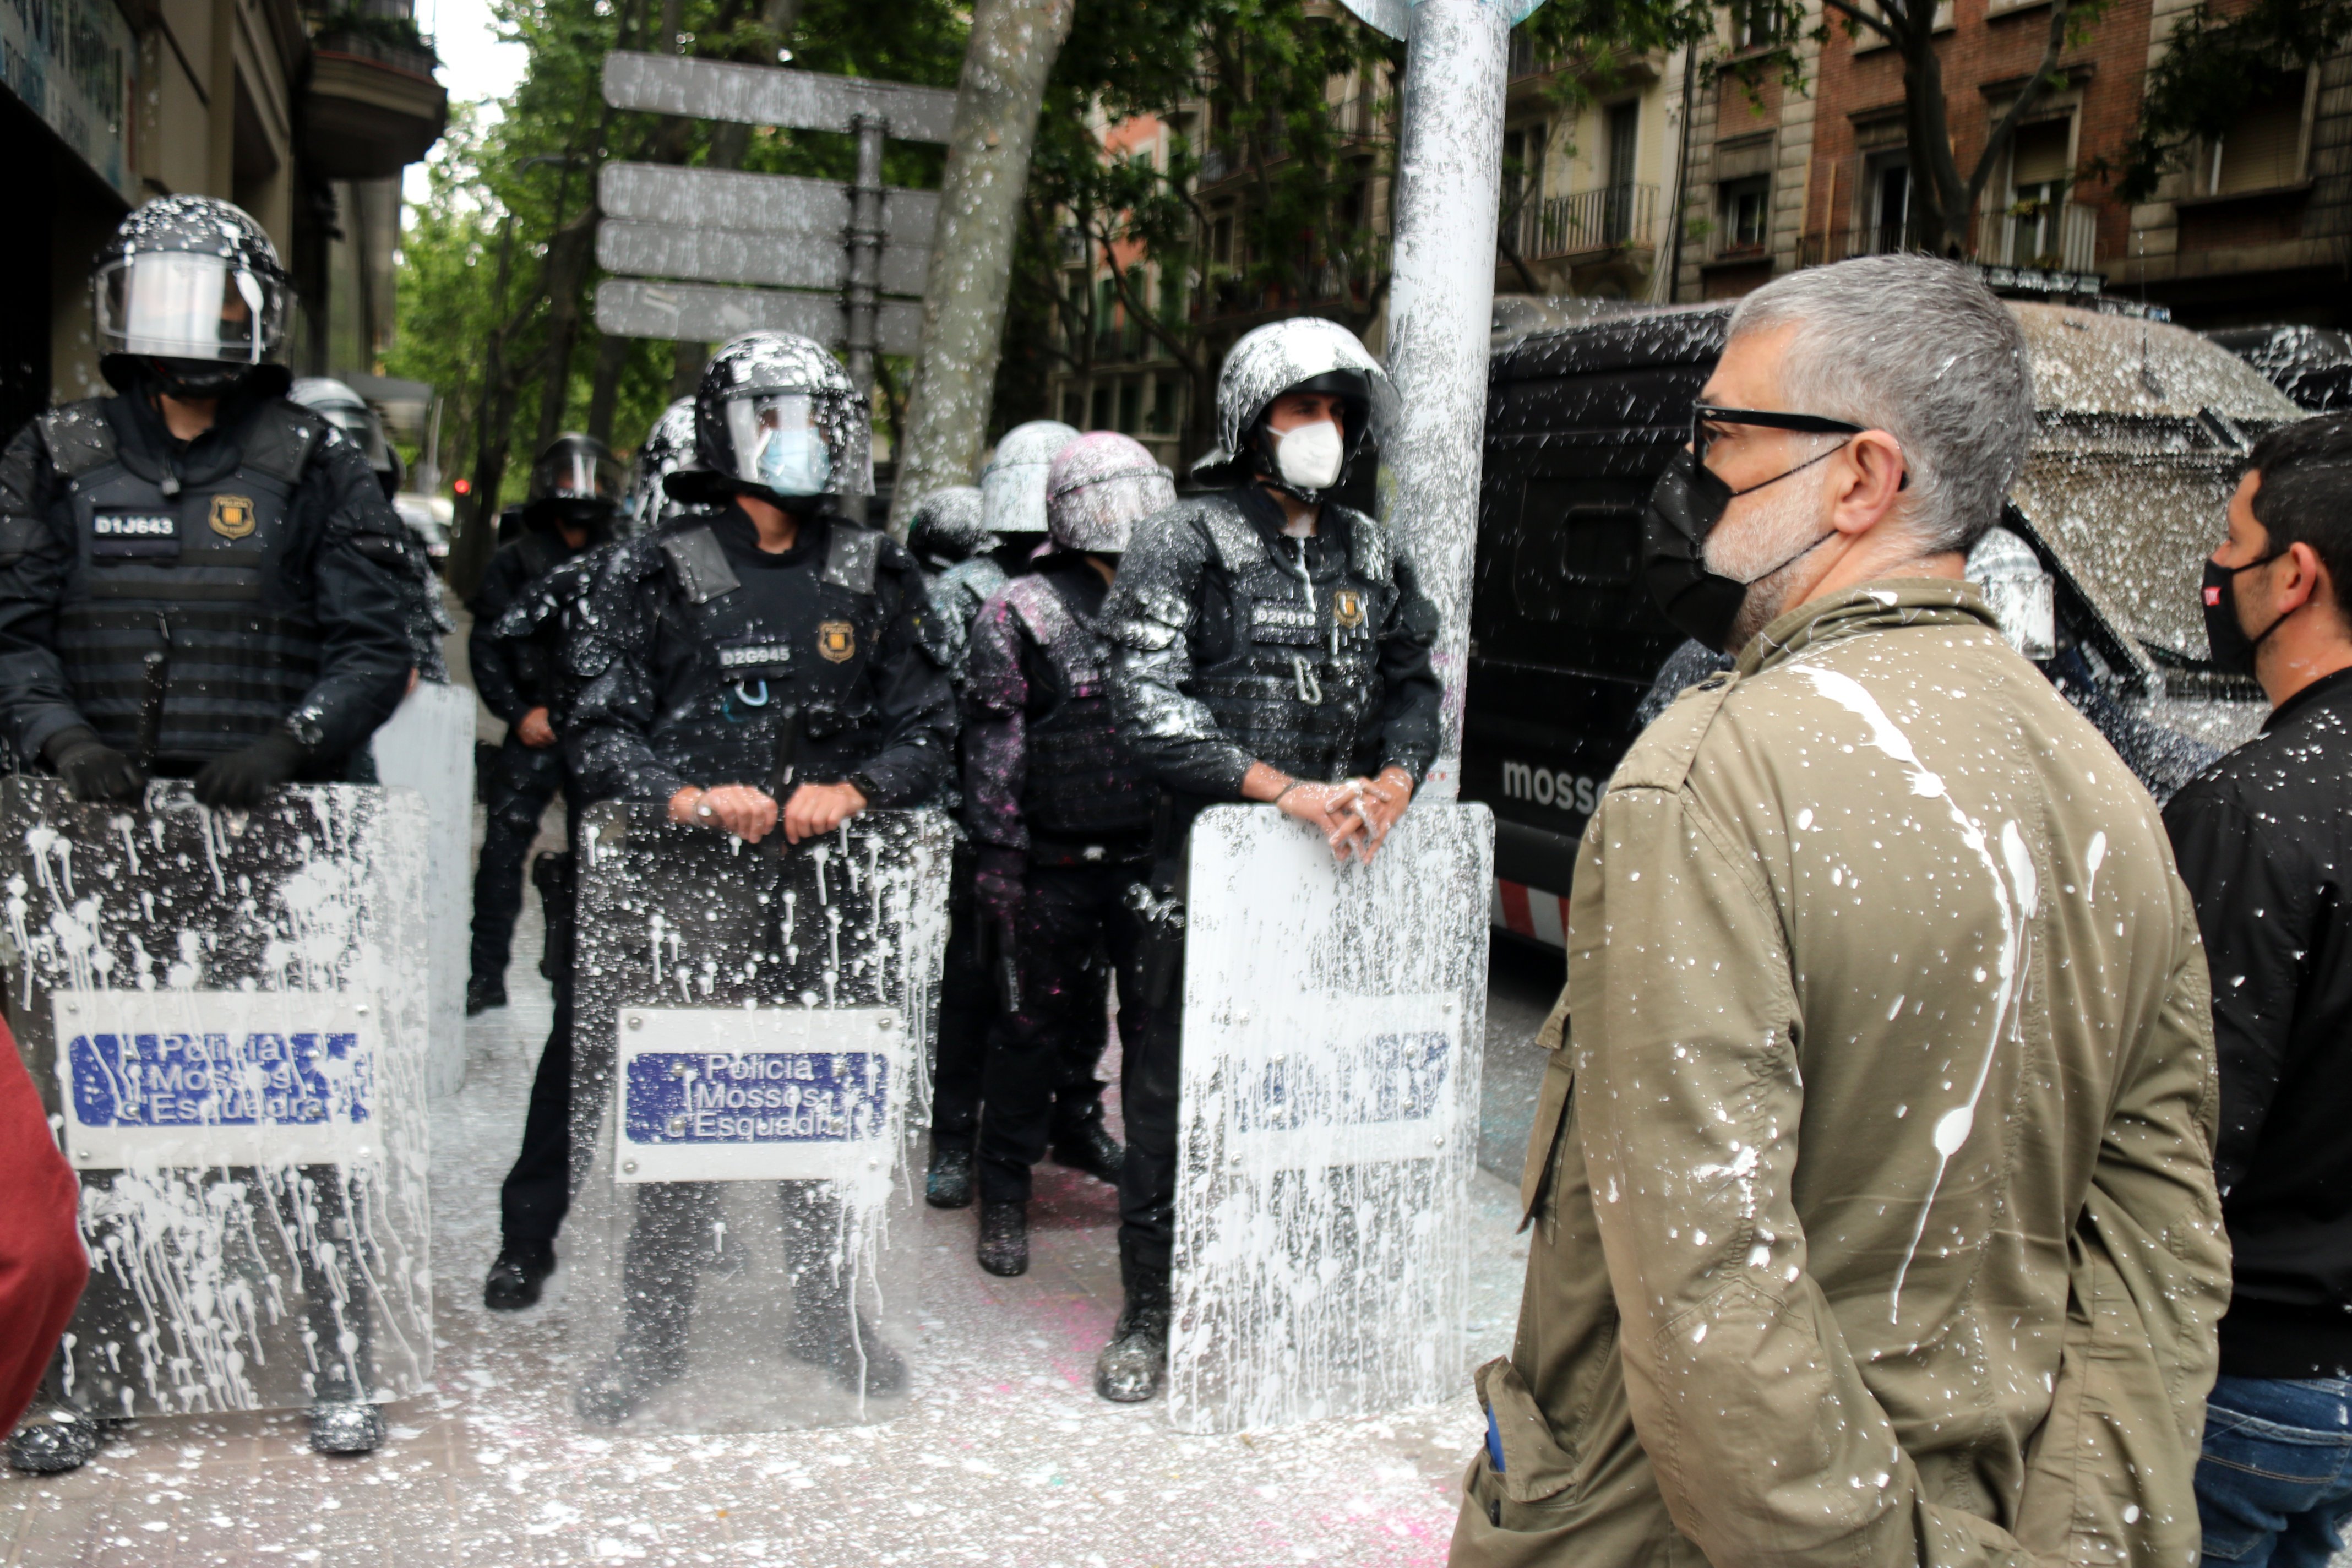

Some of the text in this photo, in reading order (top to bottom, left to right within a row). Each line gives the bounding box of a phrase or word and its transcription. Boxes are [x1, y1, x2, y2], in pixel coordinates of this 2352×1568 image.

[94, 516, 173, 535] D1J643
[720, 646, 790, 666] D2G945
[705, 1053, 814, 1081] Policia
[695, 1082, 821, 1109] Mossos
